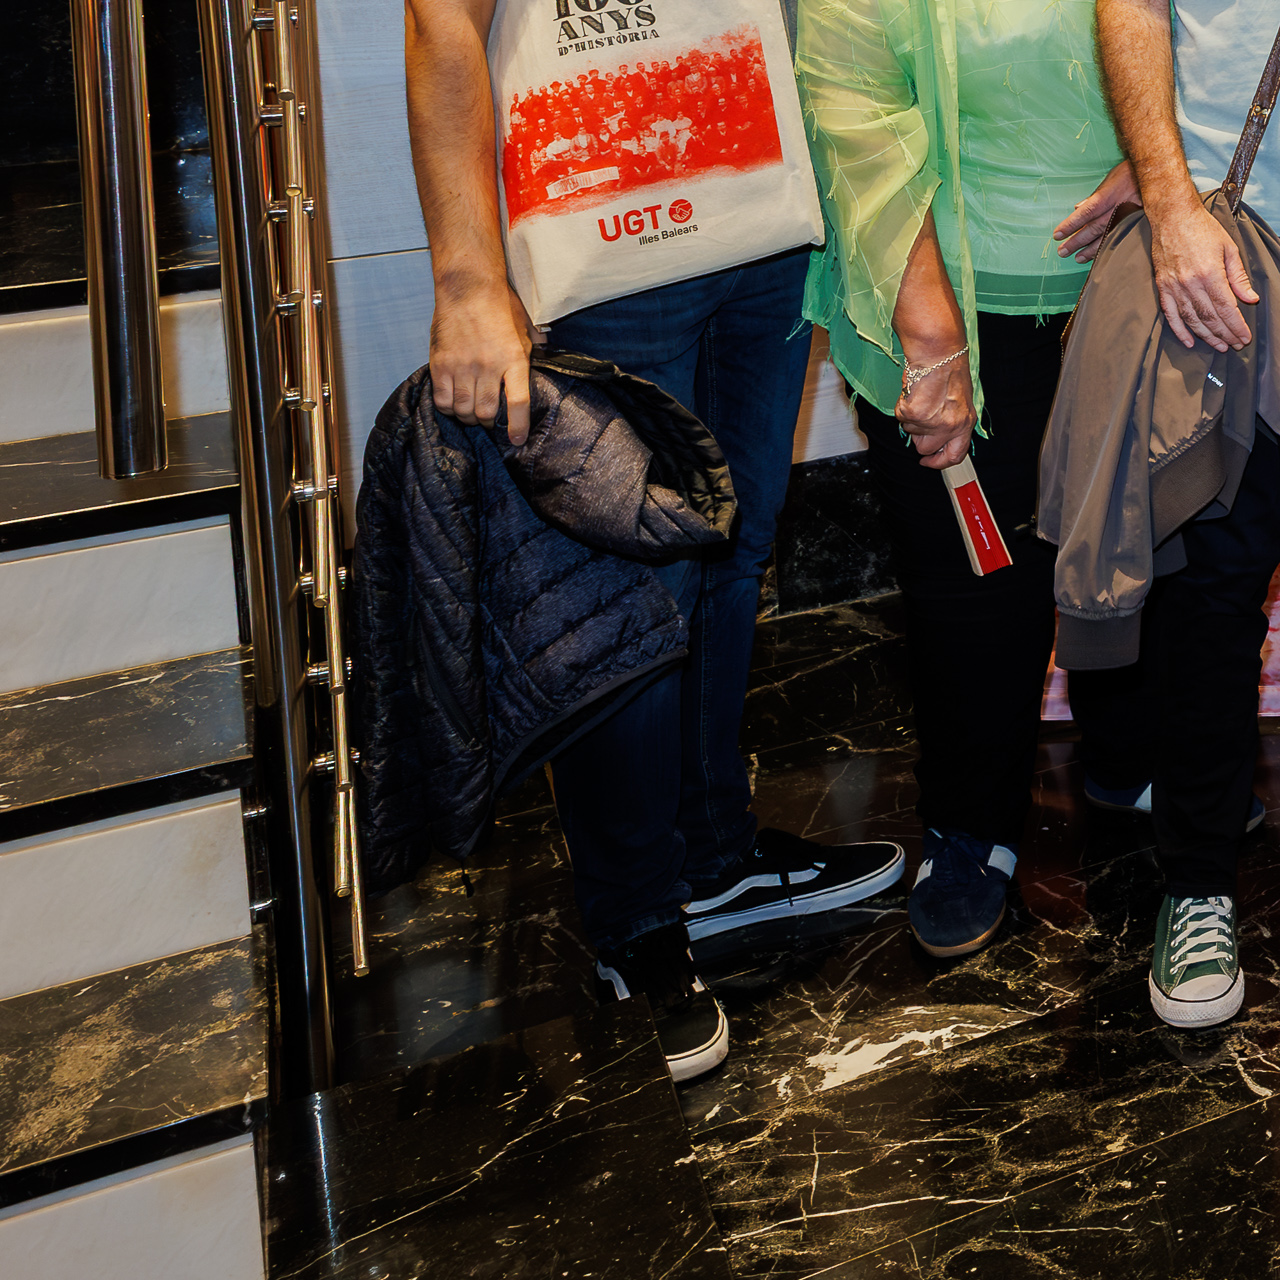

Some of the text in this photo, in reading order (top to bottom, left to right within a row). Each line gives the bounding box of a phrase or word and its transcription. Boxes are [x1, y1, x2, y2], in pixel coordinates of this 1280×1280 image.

[556, 4, 656, 44] ANYS
[597, 204, 662, 242] UGT
[639, 224, 699, 246] Illes Balears
